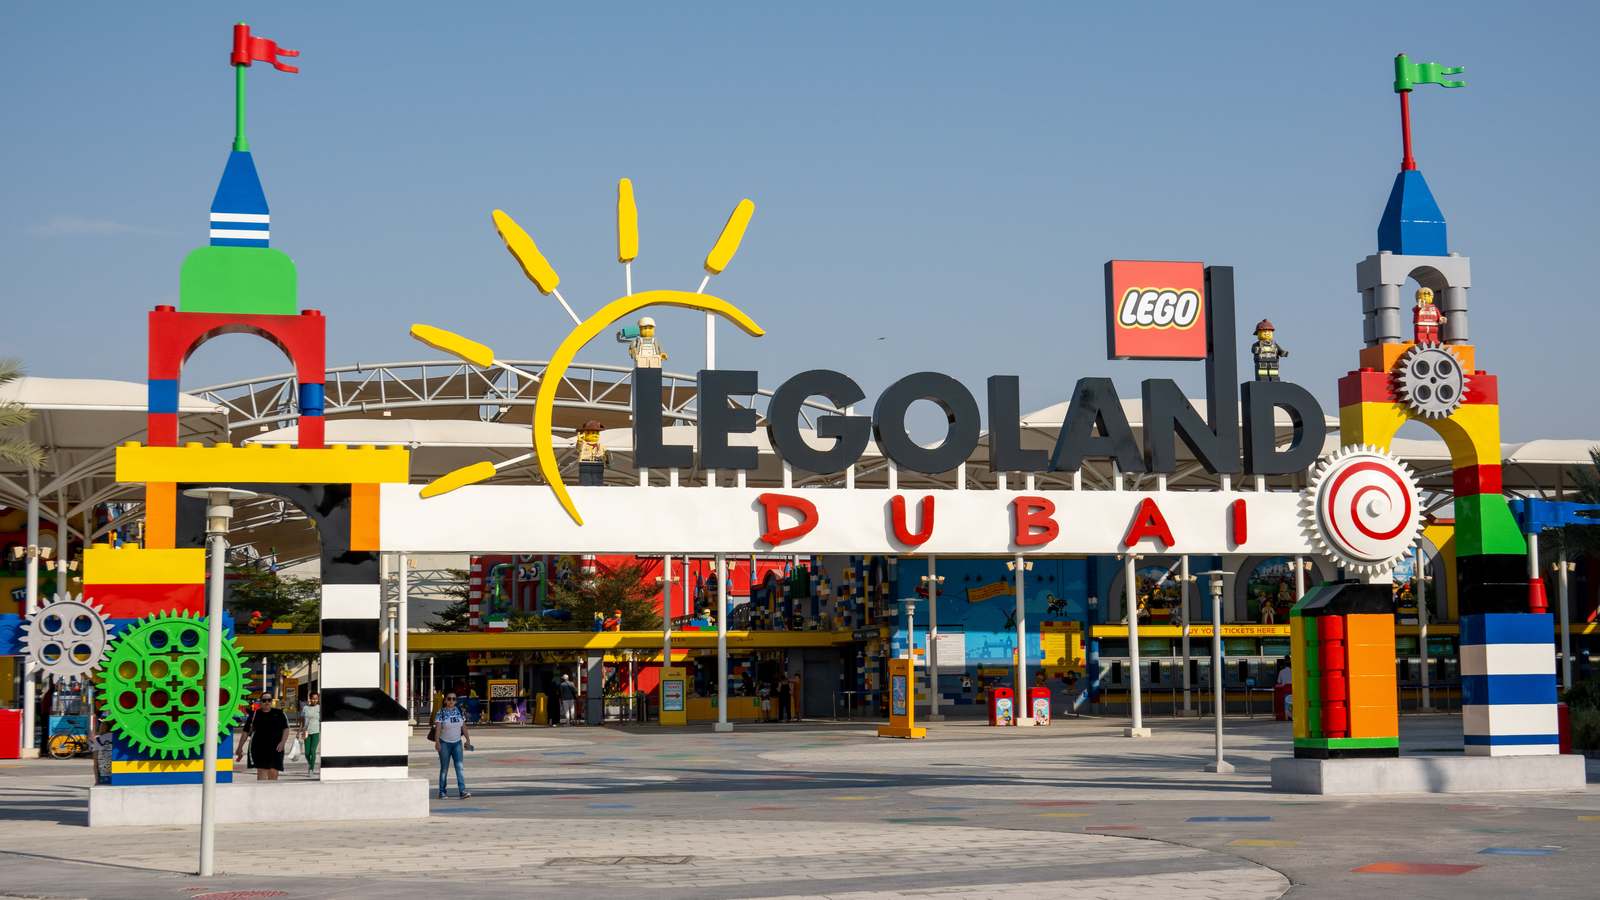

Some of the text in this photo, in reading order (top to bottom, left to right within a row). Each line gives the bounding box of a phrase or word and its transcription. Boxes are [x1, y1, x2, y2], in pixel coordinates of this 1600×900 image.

[1119, 289, 1200, 328] LEGO
[633, 366, 1326, 477] LEGOLAND
[757, 493, 1247, 551] DUBAI
